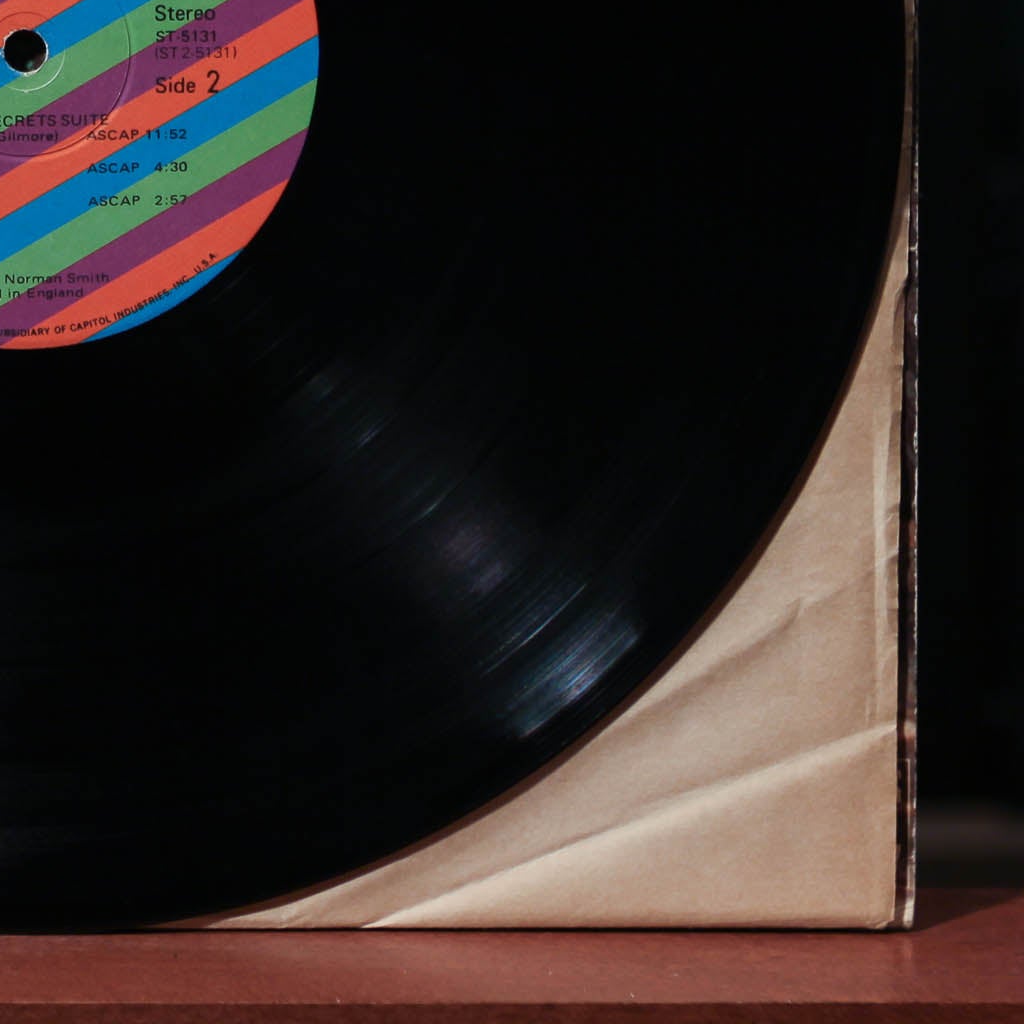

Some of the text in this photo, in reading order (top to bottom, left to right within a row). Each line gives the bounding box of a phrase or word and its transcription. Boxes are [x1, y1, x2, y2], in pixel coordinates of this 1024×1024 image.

[155, 4, 216, 22] Stereo
[155, 69, 220, 94] Side 2
[62, 114, 109, 126] SUITE
[86, 128, 187, 141] ASCAP 11:52
[88, 161, 188, 174] ASCAP 4:30
[88, 195, 187, 207] ASCAP 2:57
[5, 273, 63, 285] Norman
[67, 272, 110, 284] Smith
[8, 288, 21, 299] in
[27, 287, 84, 300] England
[54, 326, 66, 334] OF
[70, 315, 112, 332] CAPITOL
